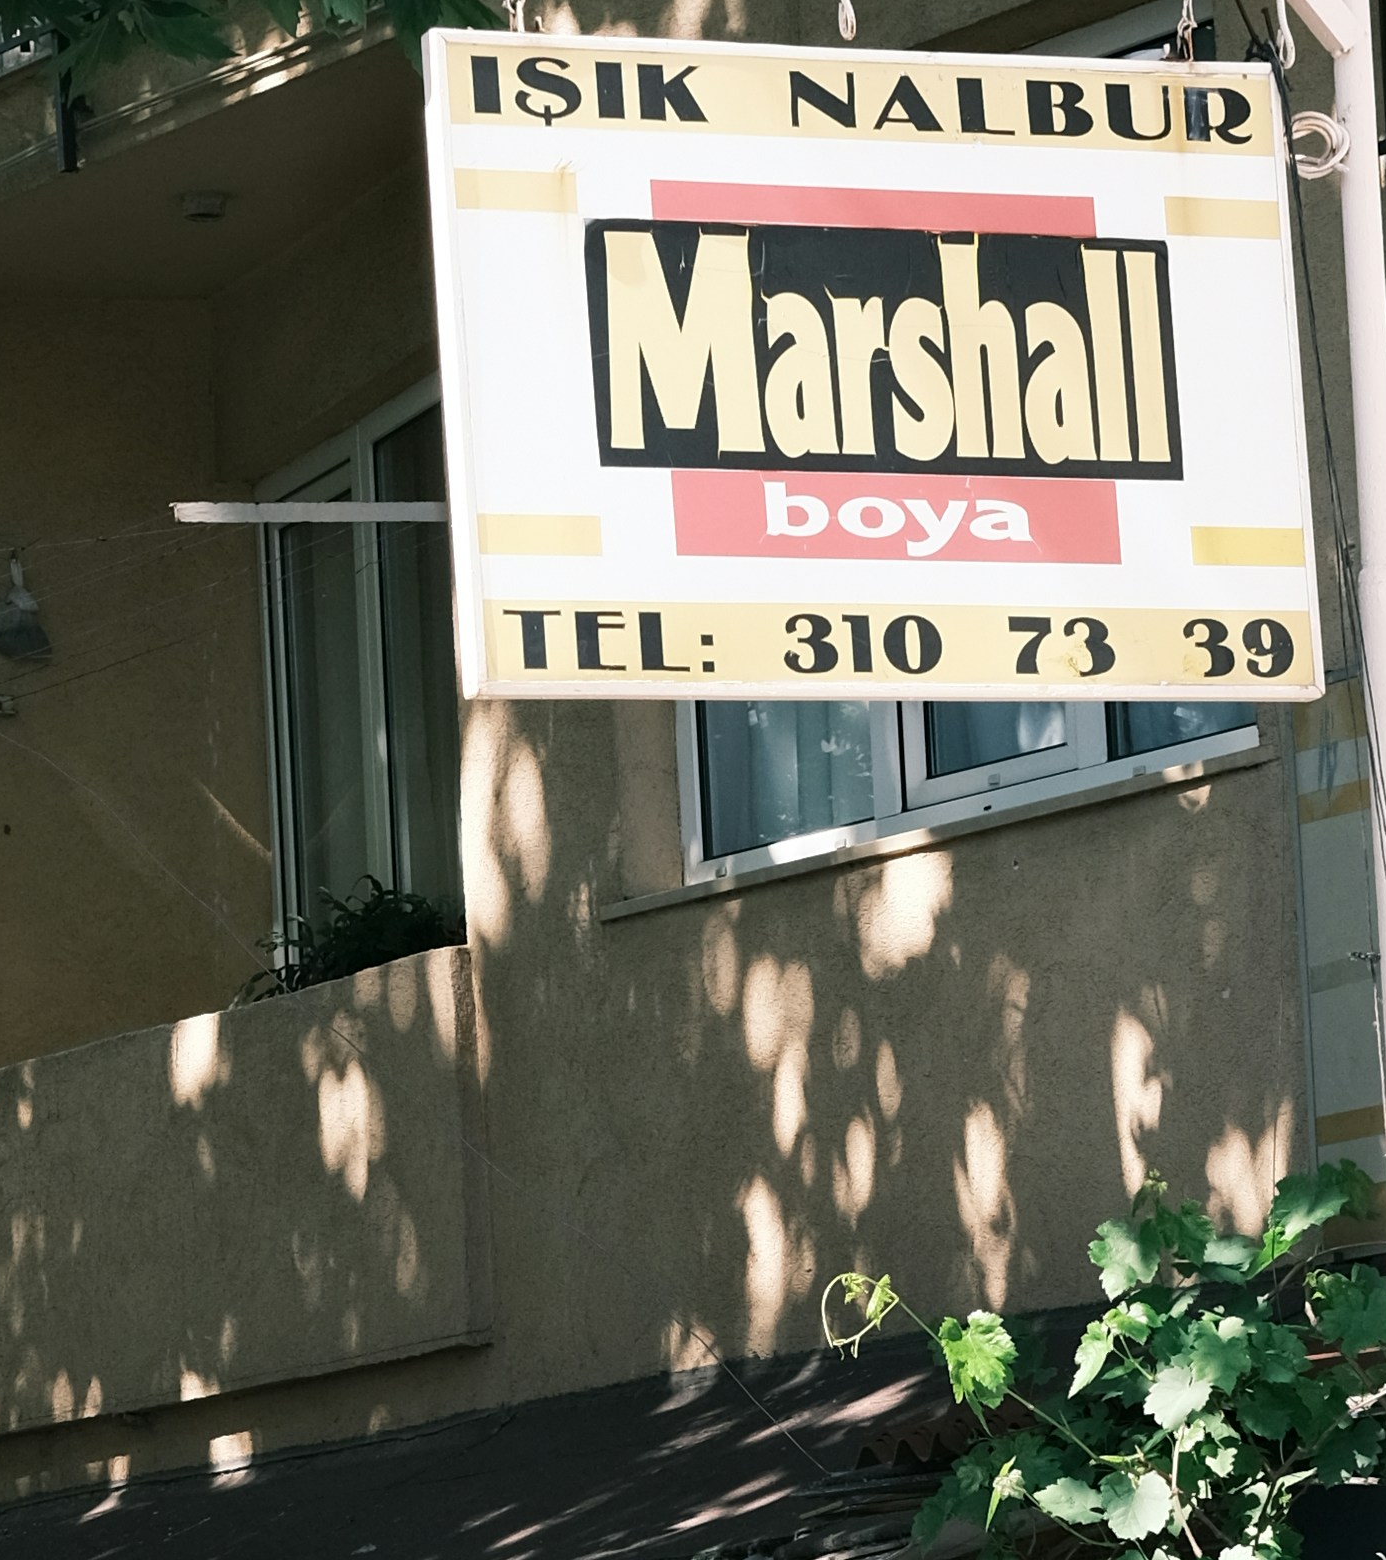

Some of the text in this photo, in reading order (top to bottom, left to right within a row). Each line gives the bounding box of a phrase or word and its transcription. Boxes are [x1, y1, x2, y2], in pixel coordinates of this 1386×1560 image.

[470, 55, 1254, 146] IŞIK NALBUR
[602, 228, 1172, 466] Marshall
[761, 480, 1035, 558] boya
[502, 608, 1295, 679] TEL: 310 73 39
